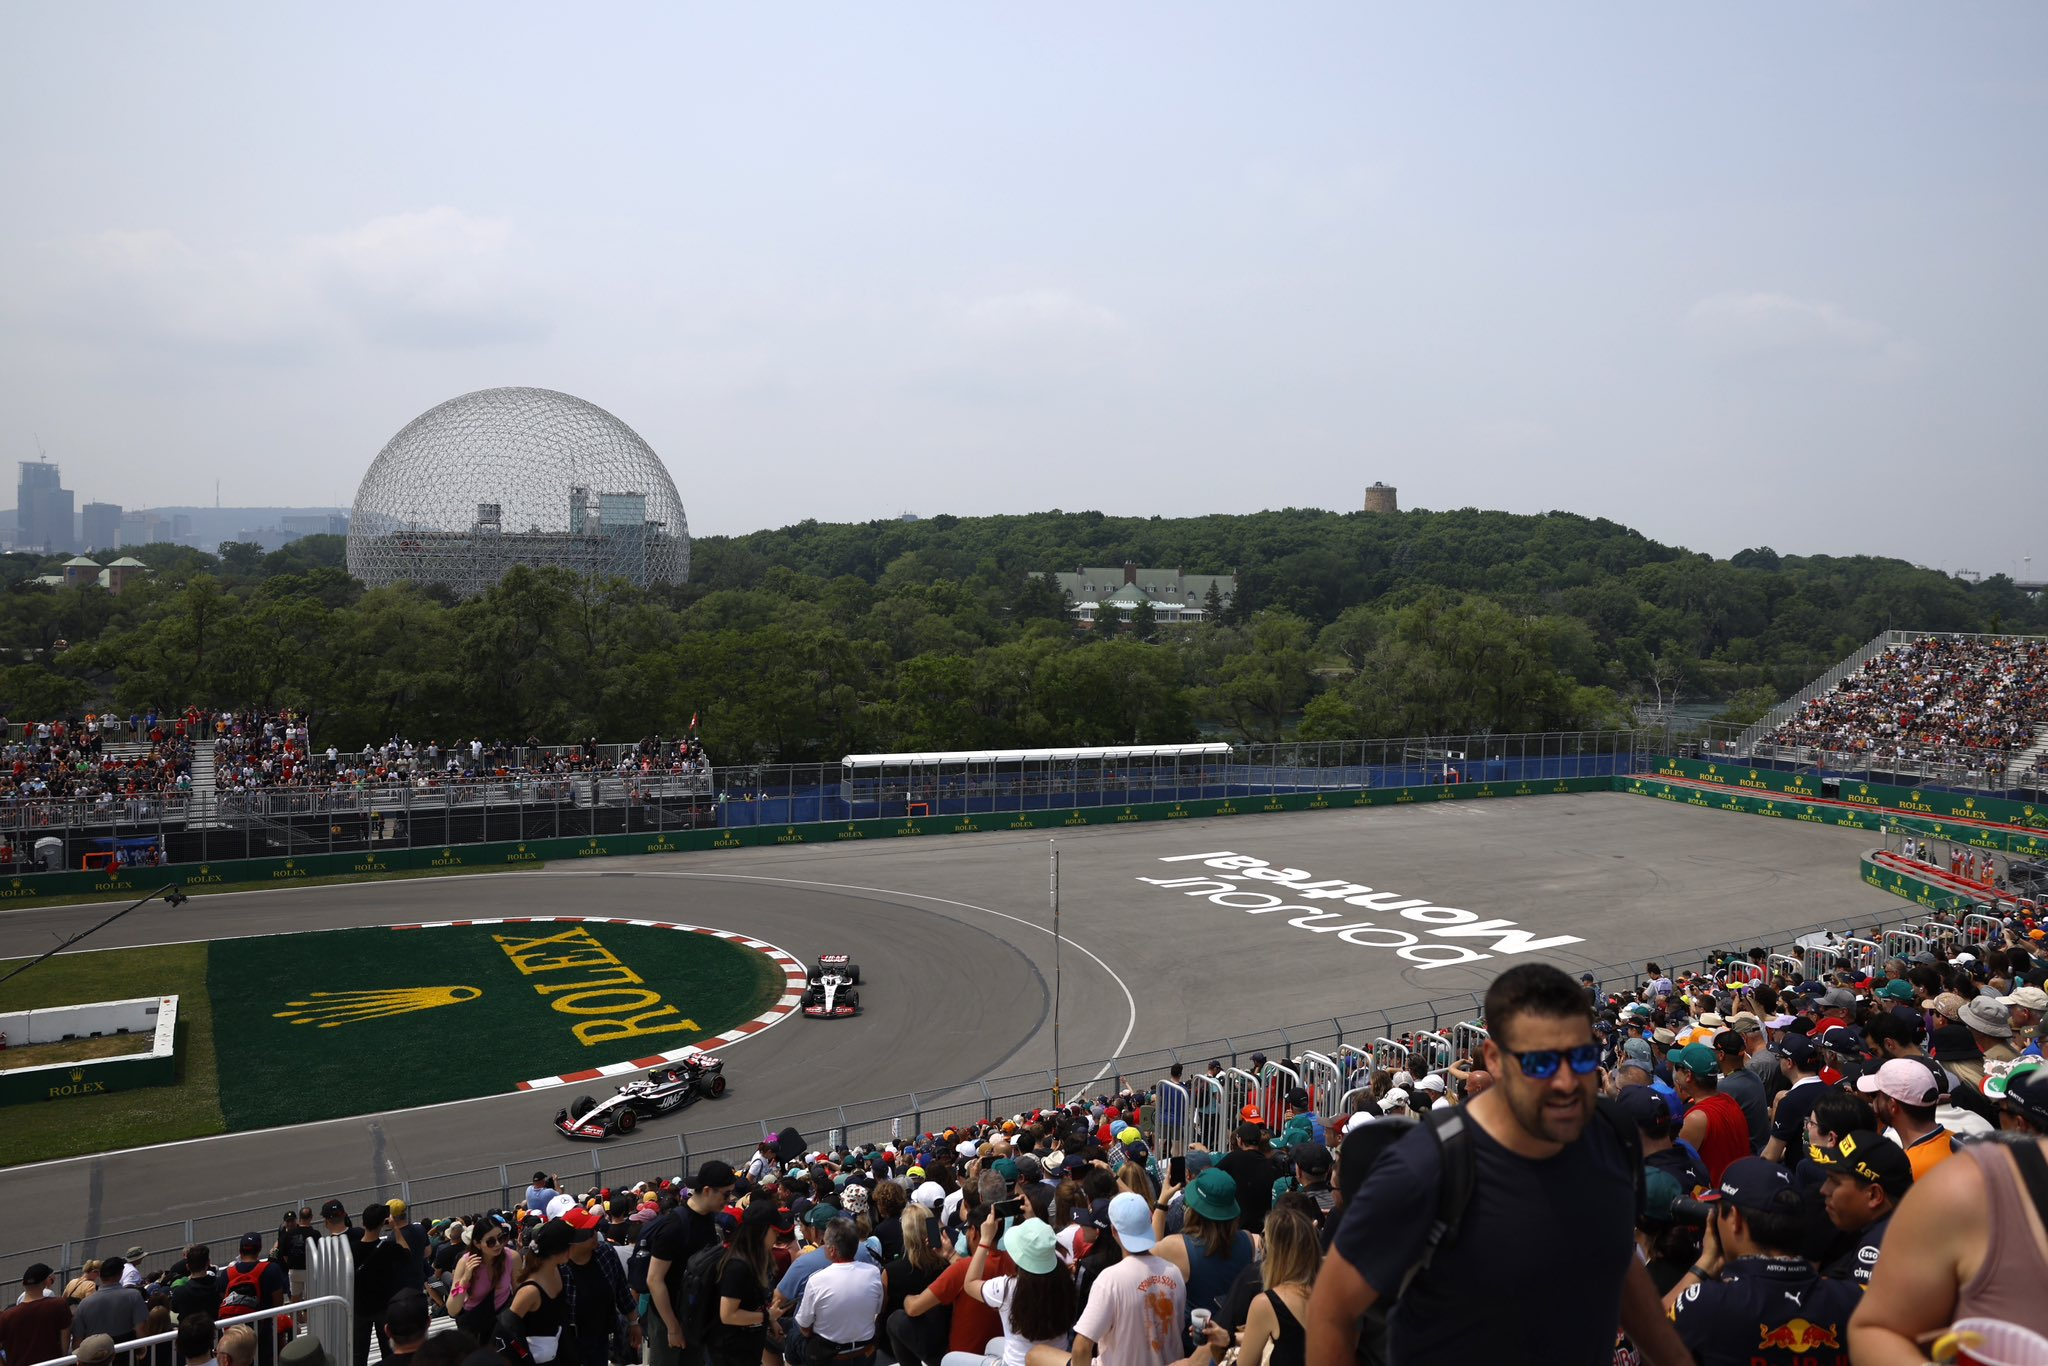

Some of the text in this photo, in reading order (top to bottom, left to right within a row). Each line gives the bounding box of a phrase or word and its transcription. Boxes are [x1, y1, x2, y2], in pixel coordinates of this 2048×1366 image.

[1659, 768, 1685, 777] ROLEX
[1699, 773, 1725, 783] ROLEX
[1740, 779, 1767, 789] ROLEX
[1784, 785, 1813, 796] ROLEX
[1310, 800, 1329, 808] ROLEX
[1354, 797, 1373, 805] ROLEX
[1687, 798, 1709, 806] ROLEX
[1848, 794, 1879, 805] ROLEX
[1264, 803, 1283, 811] ROLEX
[1722, 803, 1745, 812] ROLEX
[1899, 800, 1932, 812] ROLEX
[1167, 810, 1188, 818] ROLEX
[1216, 807, 1237, 815] ROLEX
[1758, 808, 1782, 817] ROLEX
[1952, 808, 1986, 819] ROLEX
[1065, 817, 1087, 825] ROLEX
[1797, 814, 1823, 823] ROLEX
[954, 824, 978, 832] ROLEX
[1010, 820, 1033, 828] ROLEX
[1838, 819, 1864, 829] ROLEX
[838, 830, 863, 839] ROLEX
[897, 827, 921, 835] ROLEX
[713, 838, 741, 847] ROLEX
[777, 834, 803, 842] ROLEX
[647, 843, 675, 852] ROLEX
[1969, 839, 1998, 849] ROLEX
[578, 847, 608, 856] ROLEX
[507, 852, 537, 861] ROLEX
[431, 857, 462, 866] ROLEX
[354, 862, 387, 871] ROLEX
[273, 868, 306, 878] ROLEX
[186, 874, 223, 884] ROLEX
[95, 881, 132, 891] ROLEX
[0, 888, 37, 897] ROLEX
[491, 926, 702, 1046] ROLEX
[50, 1081, 105, 1097] ROLEX
[1766, 1264, 1807, 1273] ASTON MARTIN
